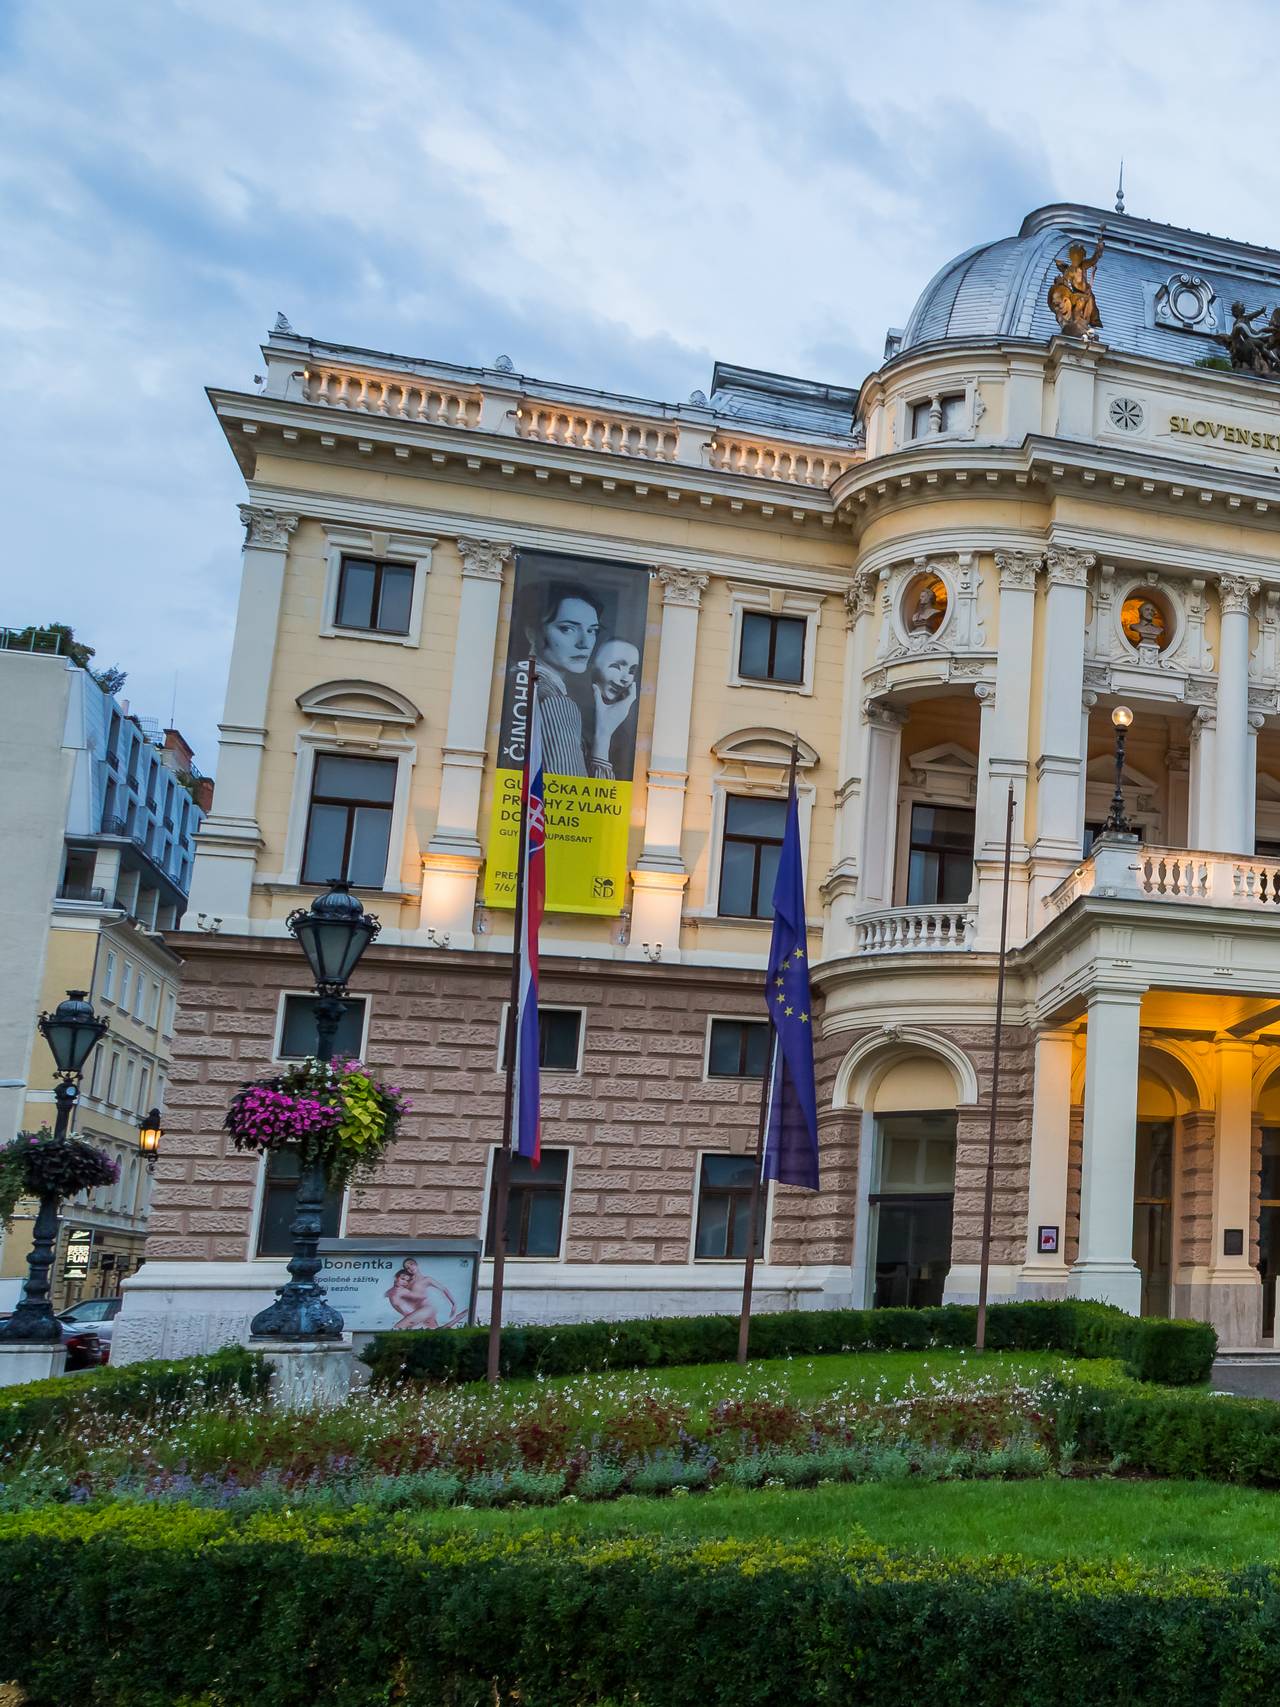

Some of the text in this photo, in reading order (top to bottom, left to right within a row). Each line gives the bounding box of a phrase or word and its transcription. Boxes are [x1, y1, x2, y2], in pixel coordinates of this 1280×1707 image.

[581, 786, 591, 797] A
[594, 786, 617, 799] INÉ
[566, 800, 575, 812] Z
[577, 801, 622, 816] VLAKU
[544, 815, 580, 828] ALAIS
[499, 828, 593, 844] GUY AUPASSANT
[67, 1255, 88, 1263] FUN
